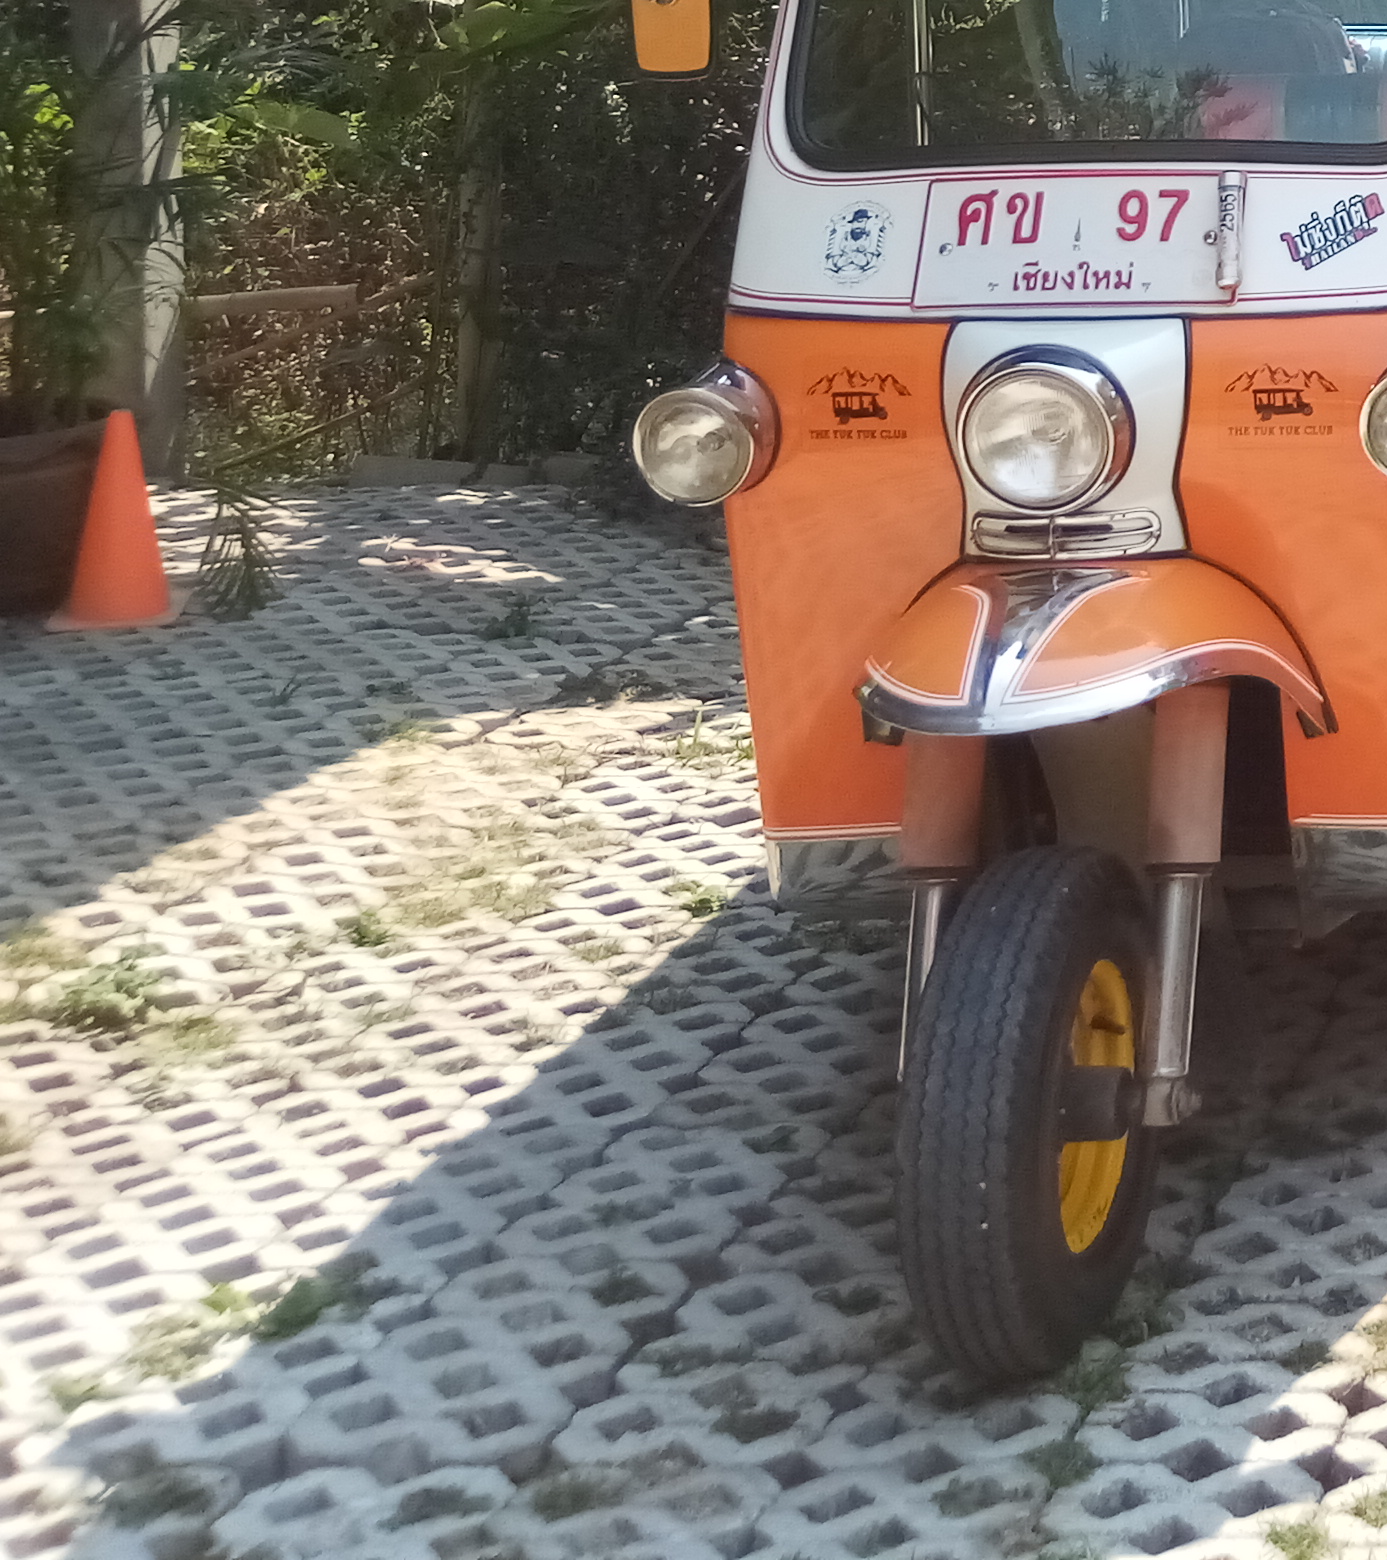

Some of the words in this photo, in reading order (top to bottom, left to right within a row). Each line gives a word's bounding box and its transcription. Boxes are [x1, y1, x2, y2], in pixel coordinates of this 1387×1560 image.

[957, 189, 1045, 246] ศข
[1116, 189, 1190, 242] 97
[1220, 193, 1238, 232] 2565
[1012, 261, 1134, 291] เชียงใหม่
[809, 430, 831, 439] THE
[880, 430, 907, 440] CLUB
[1228, 426, 1250, 436] THE
[1304, 425, 1333, 435] CLUB
